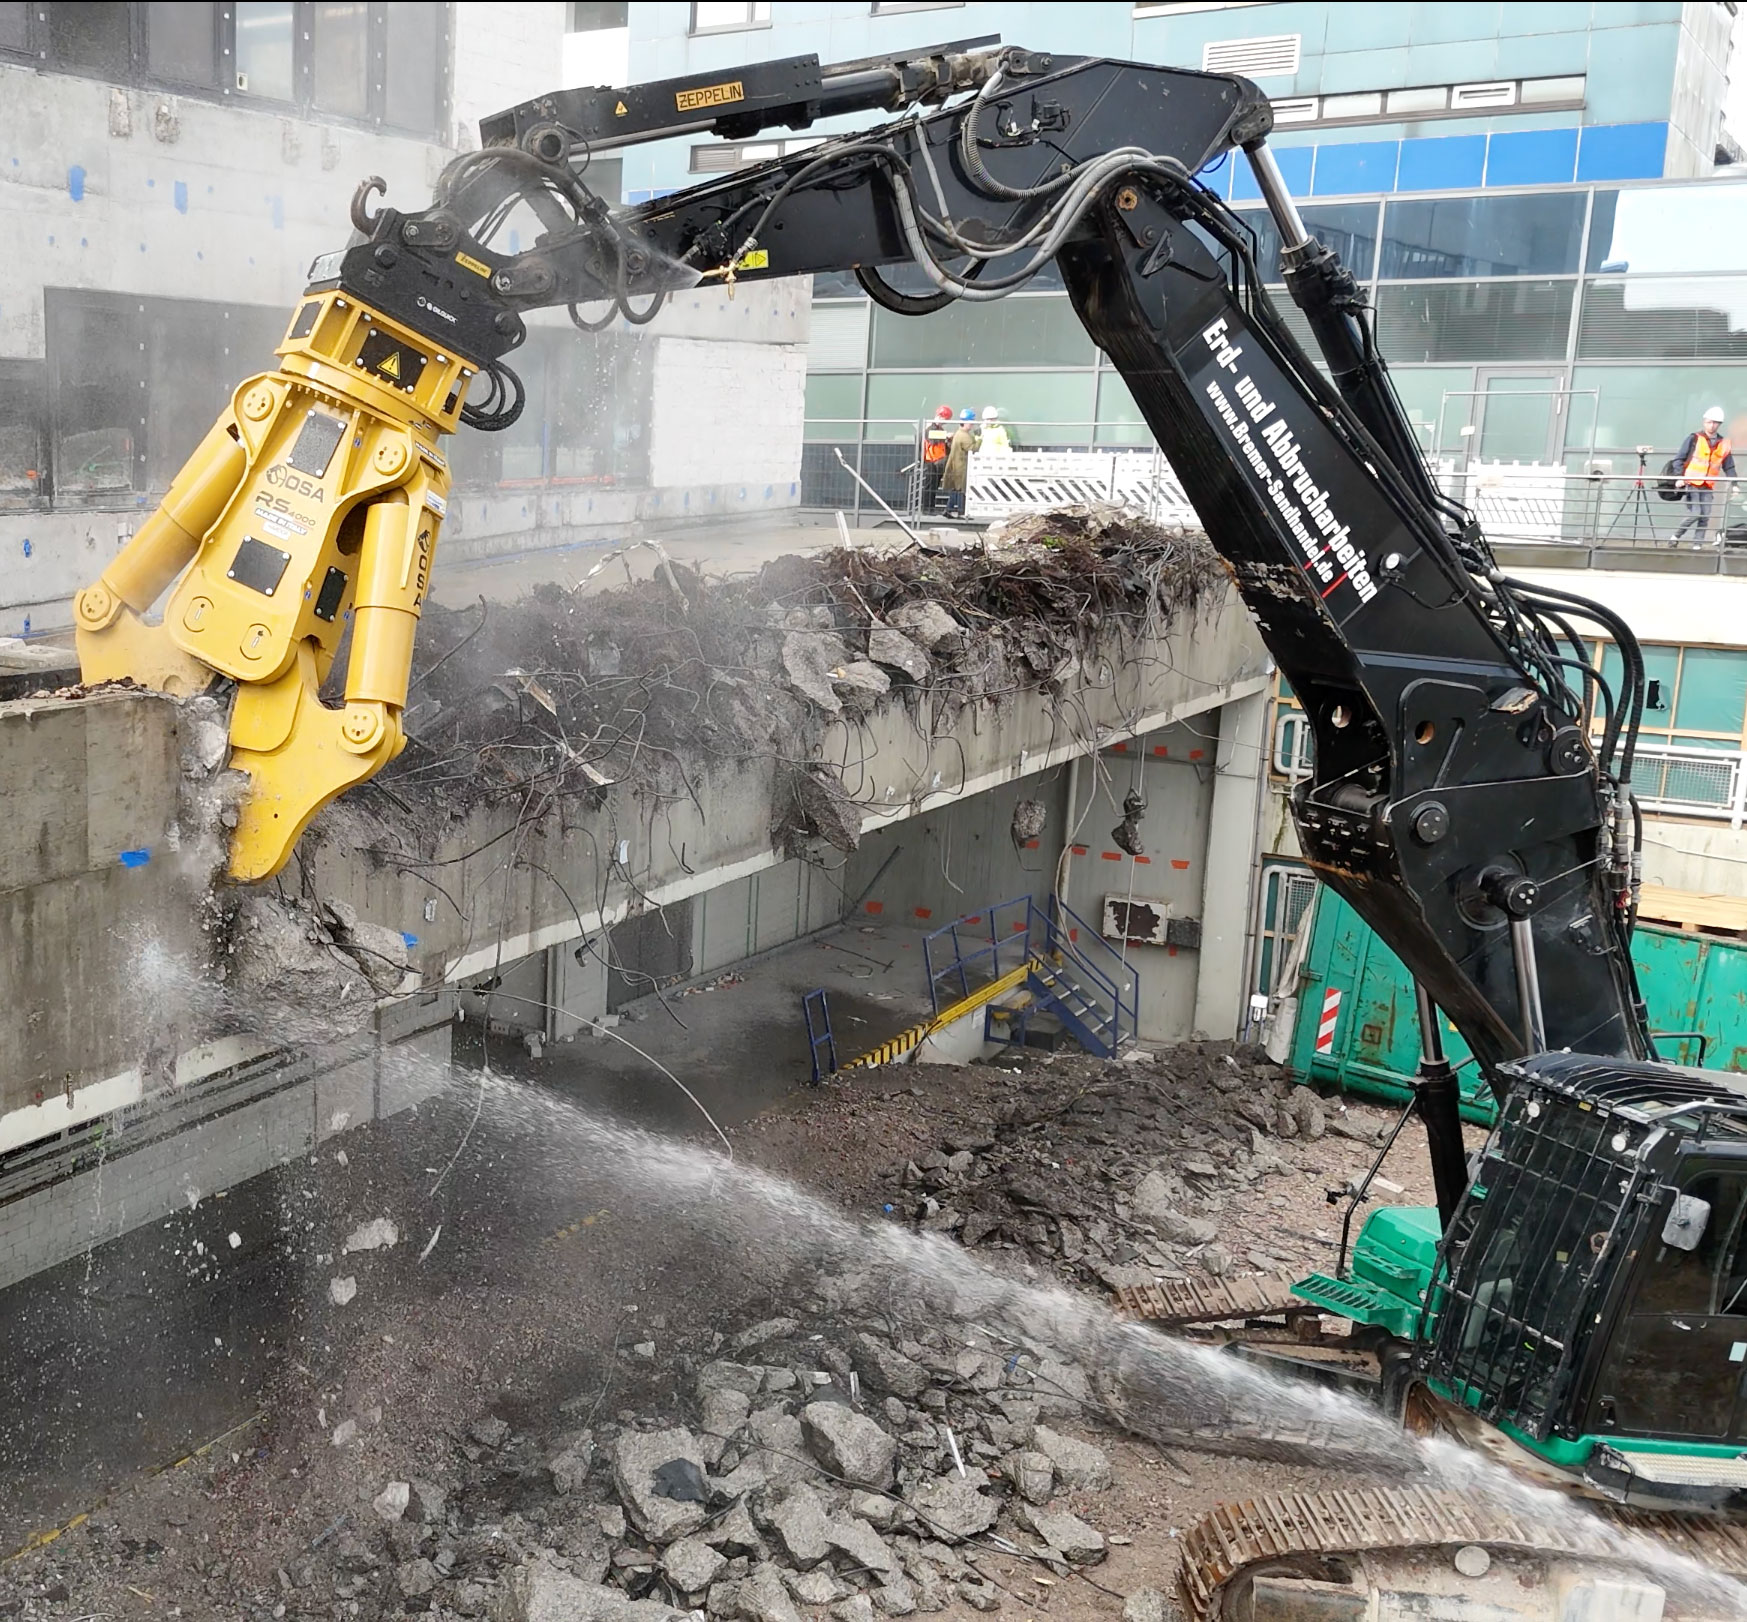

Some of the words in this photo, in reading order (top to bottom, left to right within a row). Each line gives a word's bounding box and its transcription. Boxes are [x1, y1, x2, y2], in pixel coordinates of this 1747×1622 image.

[678, 84, 742, 109] ZEPPELIN
[285, 475, 325, 503] OSA
[1202, 318, 1243, 374] Erd-
[1234, 375, 1277, 424] und
[1261, 418, 1378, 604] Abbrucharbeiten
[1205, 380, 1334, 584] www.Bremer-Sandhandel.de
[413, 554, 428, 610] OSA
